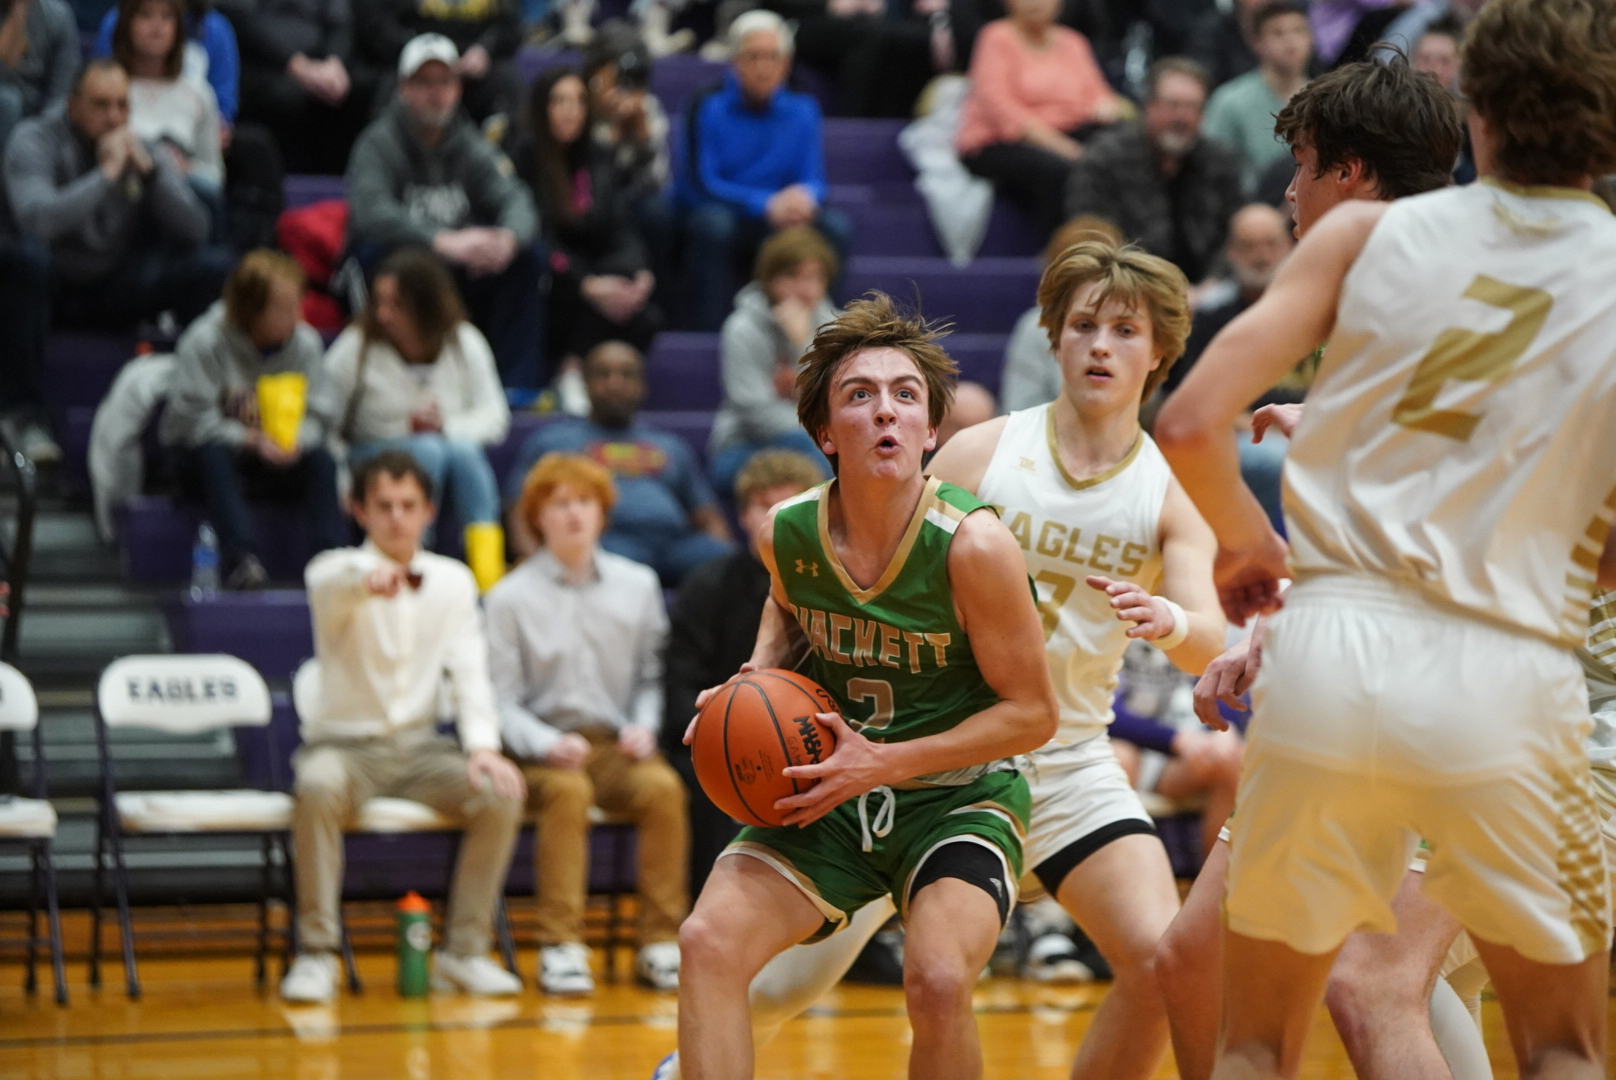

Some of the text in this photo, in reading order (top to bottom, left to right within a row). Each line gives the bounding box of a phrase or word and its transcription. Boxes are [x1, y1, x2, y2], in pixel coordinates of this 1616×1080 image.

[1391, 273, 1554, 443] 2
[993, 504, 1148, 577] AGLES
[846, 677, 895, 734] 2
[787, 736, 803, 766] GAM
